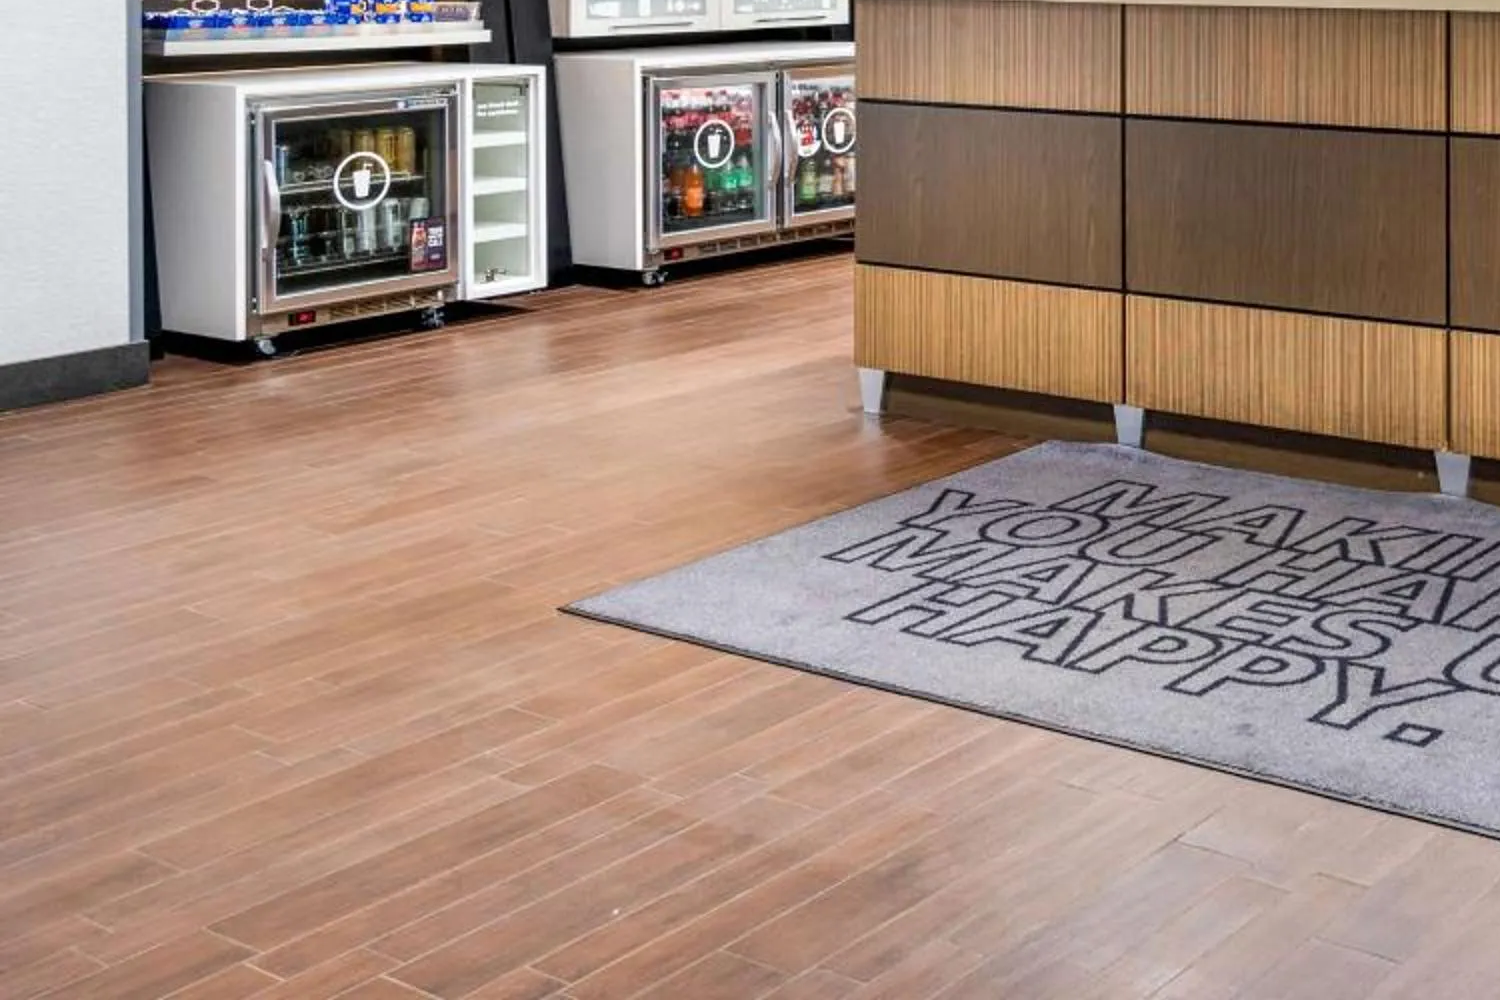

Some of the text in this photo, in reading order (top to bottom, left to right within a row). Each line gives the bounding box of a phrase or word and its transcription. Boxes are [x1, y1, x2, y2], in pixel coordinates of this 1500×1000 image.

[822, 525, 1425, 661] MAKES
[897, 488, 1220, 566] YOU
[843, 582, 1470, 747] HAPPY.
